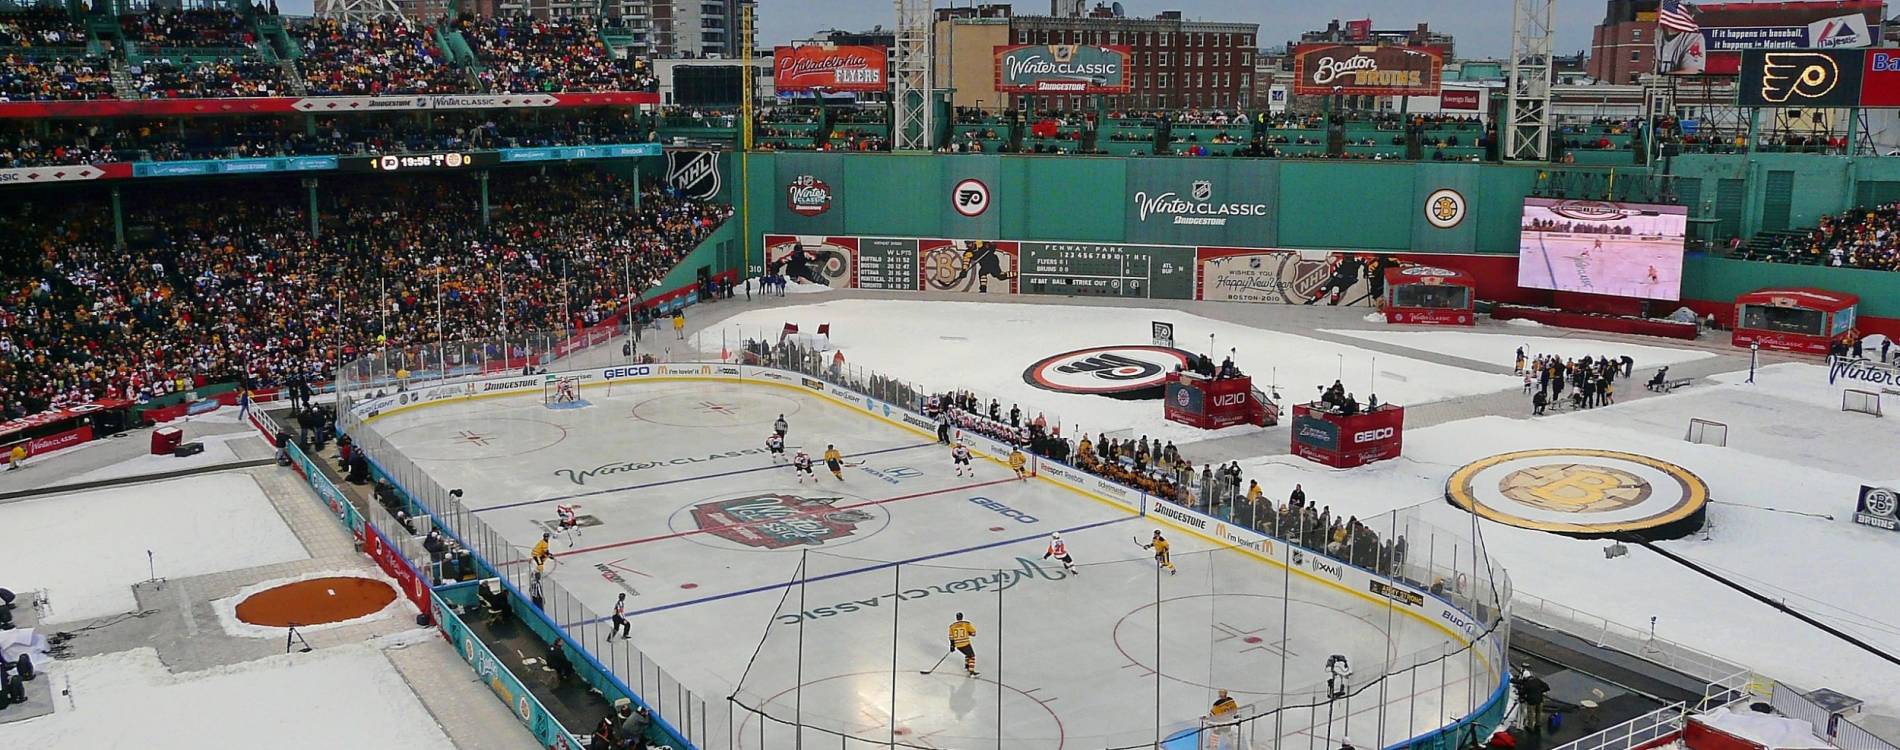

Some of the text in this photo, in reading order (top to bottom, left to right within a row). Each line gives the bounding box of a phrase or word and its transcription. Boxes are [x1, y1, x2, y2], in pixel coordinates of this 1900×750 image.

[1727, 29, 1758, 40] happens
[1760, 29, 1767, 37] in
[780, 54, 868, 80] Philadelphia
[1006, 56, 1116, 81] Winter CLASSIC
[1313, 54, 1377, 85] Boston
[834, 68, 880, 83] FLYERS
[1355, 70, 1422, 86] BRUINS
[370, 159, 378, 169] 1
[400, 157, 431, 167] 19:56
[463, 155, 471, 165] 0
[678, 158, 710, 190] NHL
[790, 186, 827, 204] Winter
[1135, 192, 1266, 221] Winter CLASSIC
[1174, 216, 1227, 226] BRIDGESTONE
[1045, 244, 1088, 252] FENWAY
[1216, 275, 1249, 292] Happy
[1246, 276, 1271, 289] New
[1300, 268, 1328, 292] NHL
[604, 366, 650, 380] GEICO
[1826, 354, 1894, 385] Winter
[484, 378, 538, 392] BRIDGESTONE
[1214, 392, 1246, 407] VIZIO
[1354, 427, 1394, 443] GEICO
[554, 461, 669, 485] Winter
[968, 496, 1039, 524] GEICO
[1154, 502, 1207, 530] BRIDGESTONE
[1858, 514, 1896, 530] BRUINS
[776, 556, 1068, 625] Winter CLASSIC
[1442, 610, 1464, 628] BUD
[954, 629, 966, 639] 33
